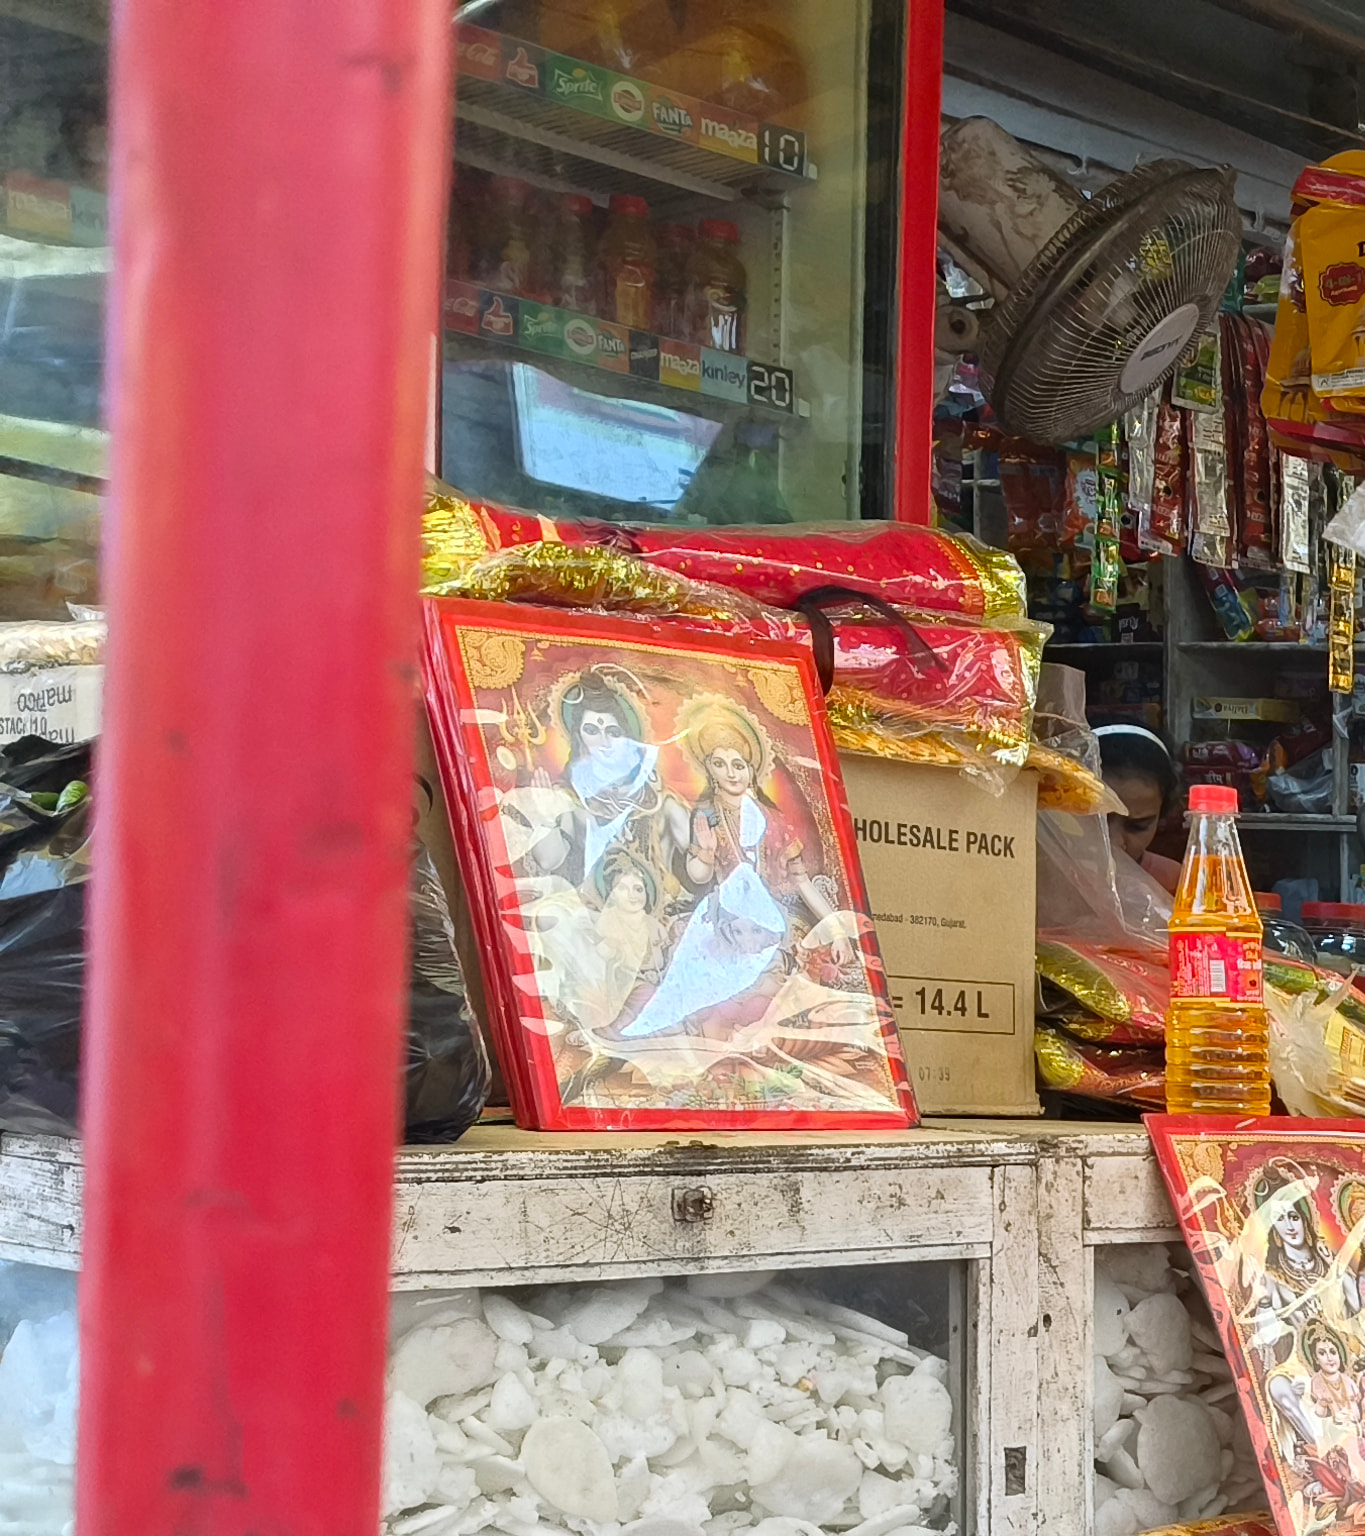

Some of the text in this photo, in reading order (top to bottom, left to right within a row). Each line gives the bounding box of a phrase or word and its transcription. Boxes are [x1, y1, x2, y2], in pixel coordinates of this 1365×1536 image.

[652, 102, 693, 129] FANTA
[700, 116, 758, 149] maaza
[659, 352, 701, 375] maaza
[702, 364, 746, 389] kinley
[750, 365, 791, 408] 20
[854, 818, 1015, 858] HOLESALE PACK
[910, 914, 940, 928] 382170,
[915, 987, 967, 1017] 14.4
[977, 991, 989, 1018] L
